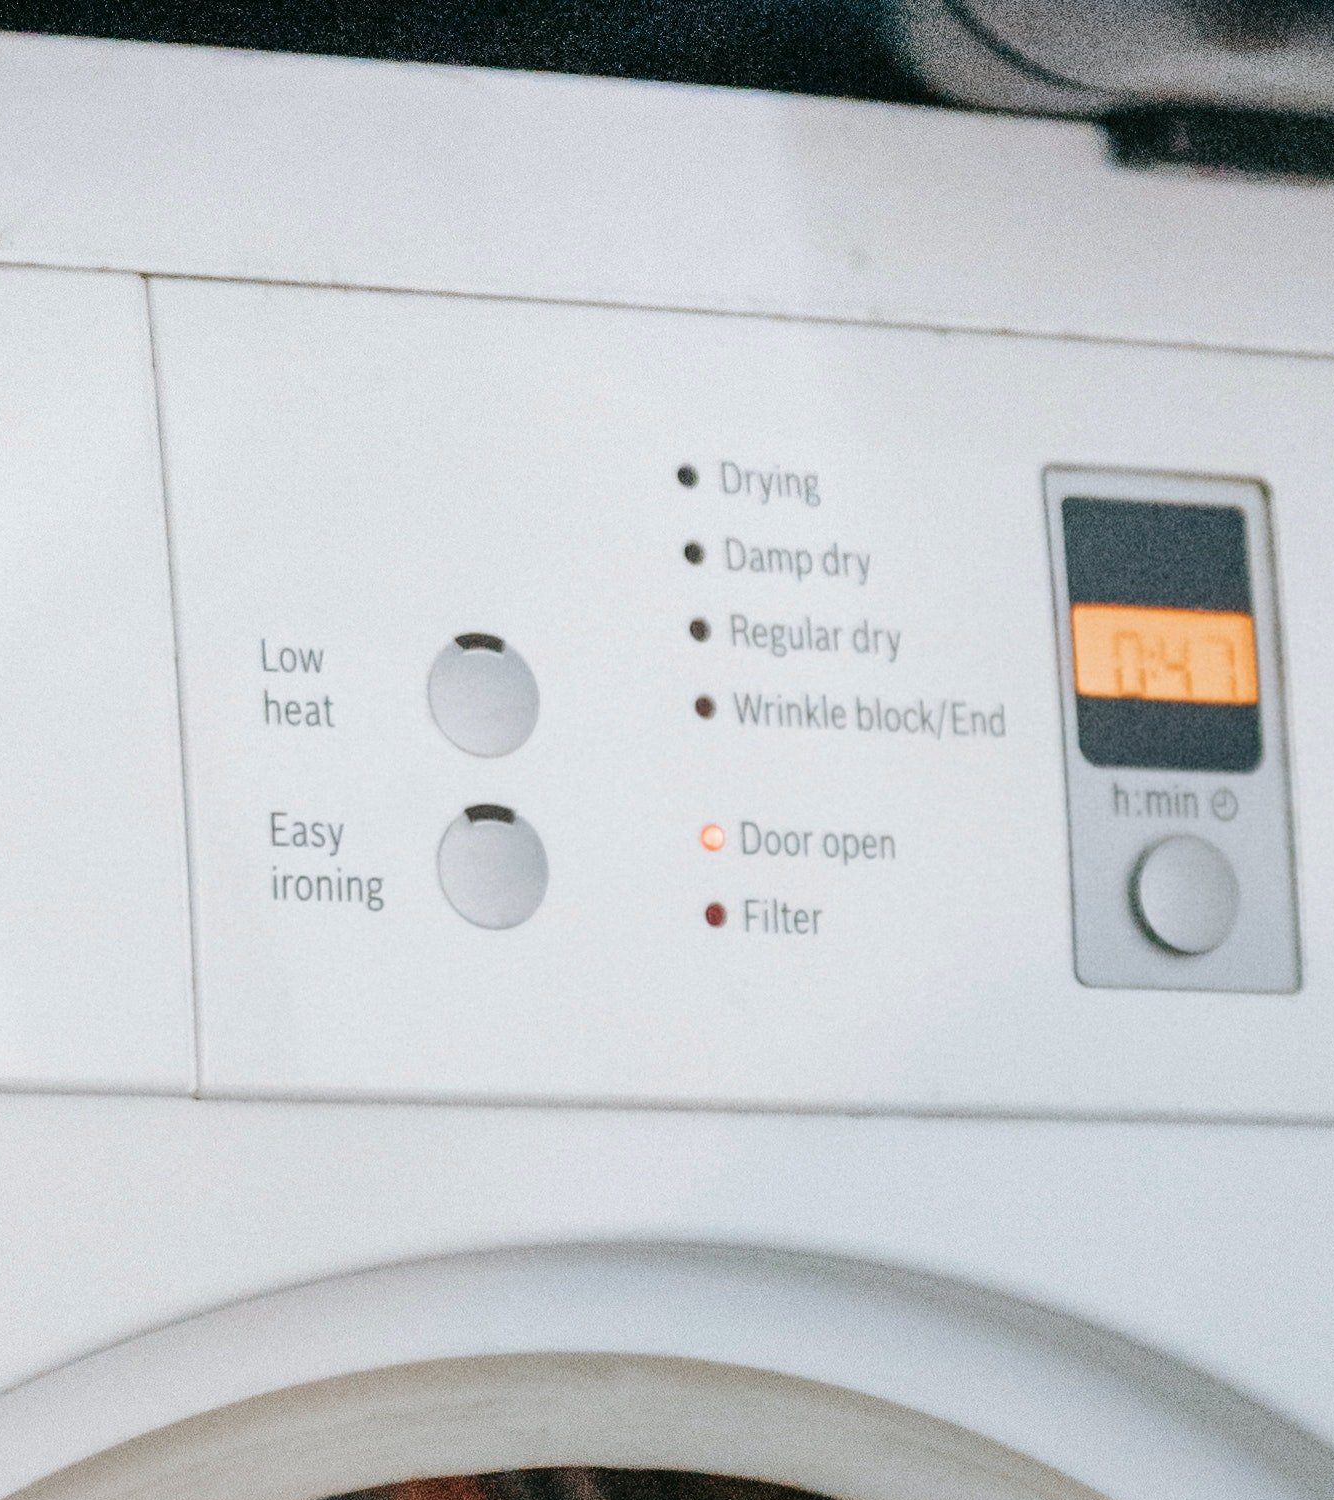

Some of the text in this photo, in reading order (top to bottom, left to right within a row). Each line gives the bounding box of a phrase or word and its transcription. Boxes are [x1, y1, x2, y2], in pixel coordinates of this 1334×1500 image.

[720, 460, 822, 508] Drying
[724, 536, 871, 586] Damp dry
[260, 638, 324, 674] Low
[729, 613, 902, 663] Regular dry
[263, 688, 335, 729] heat
[732, 691, 1007, 741] Wrinkle block/End
[1113, 782, 1200, 819] h:min
[269, 811, 345, 858] Easy
[739, 820, 897, 866] Door open
[271, 865, 386, 912] ironing
[743, 898, 823, 935] Filter
